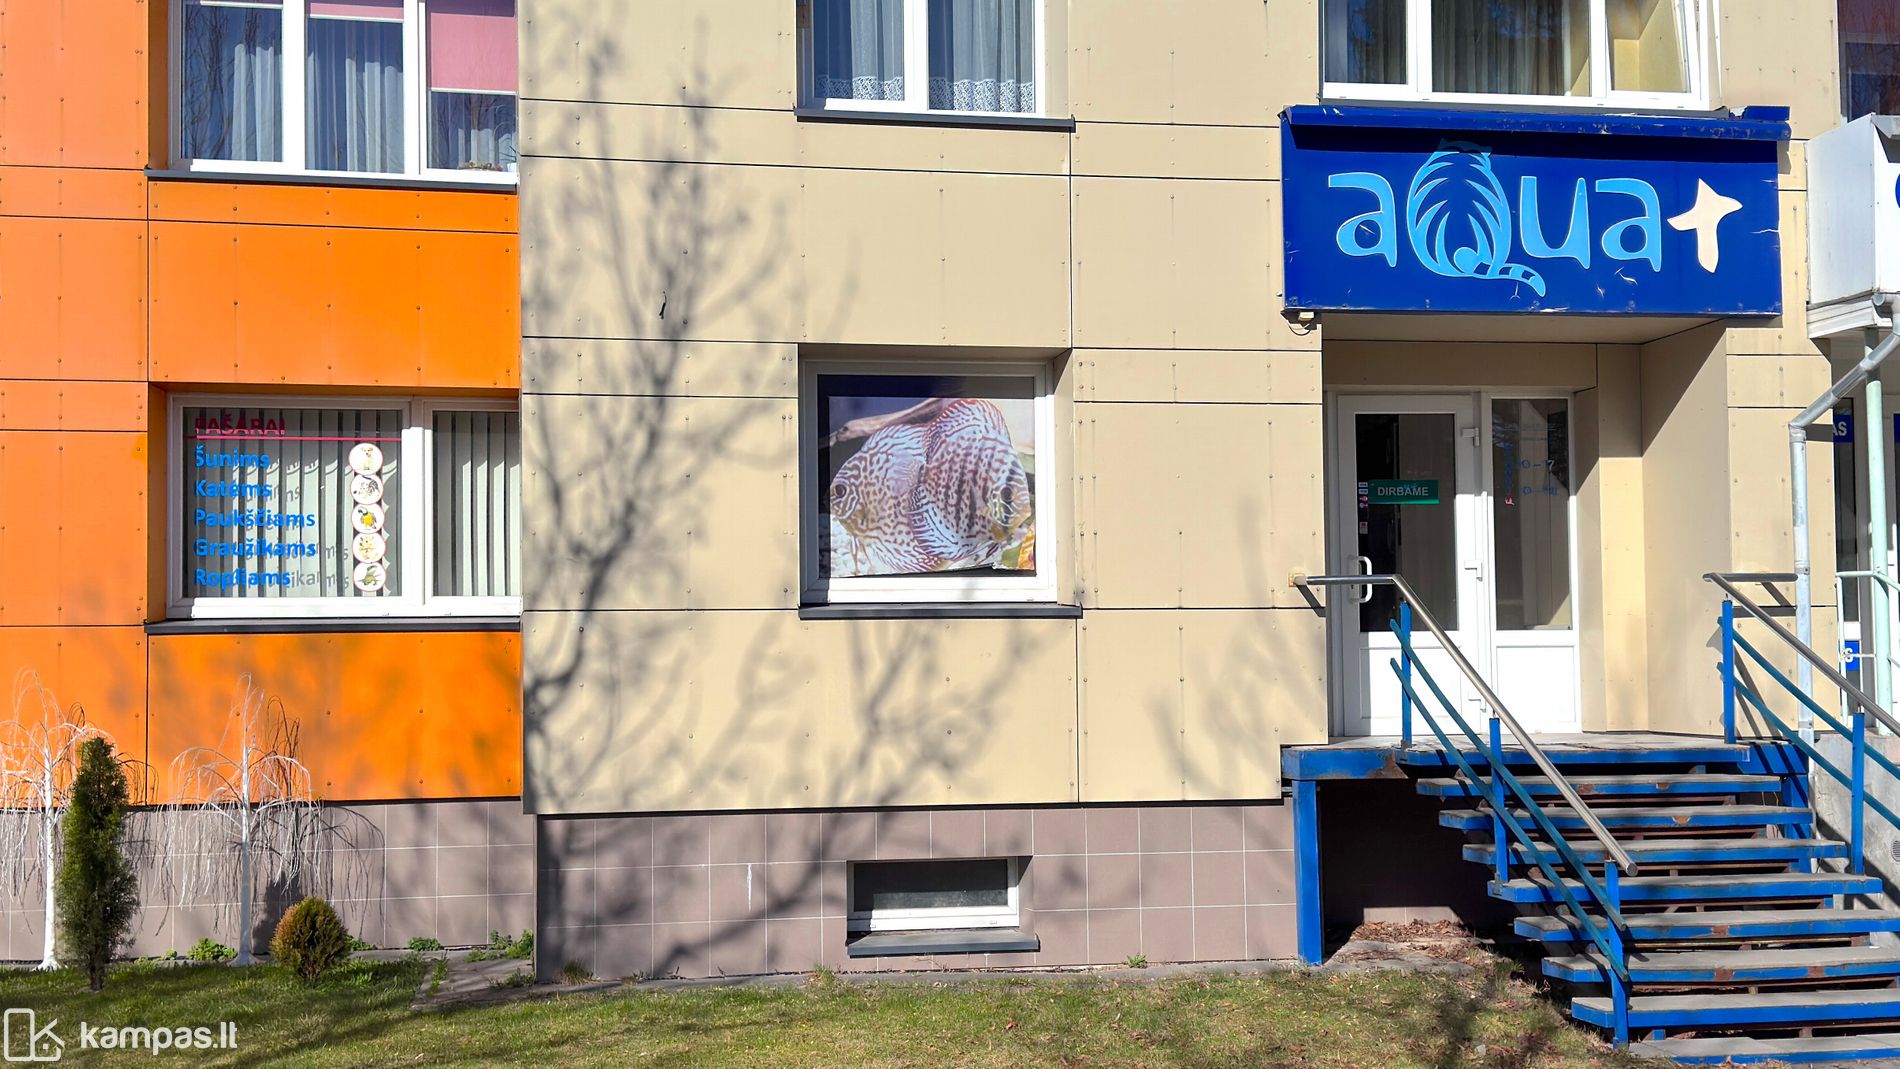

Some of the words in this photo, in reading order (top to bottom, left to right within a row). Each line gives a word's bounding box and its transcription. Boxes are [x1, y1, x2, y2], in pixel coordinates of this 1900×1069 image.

[195, 444, 271, 468] Šunims
[195, 480, 272, 498] Katėms
[1377, 486, 1429, 496] DIRBAME
[195, 509, 316, 528] Paukščiams
[195, 538, 316, 557] Graužikams
[195, 568, 291, 590] Ropliams
